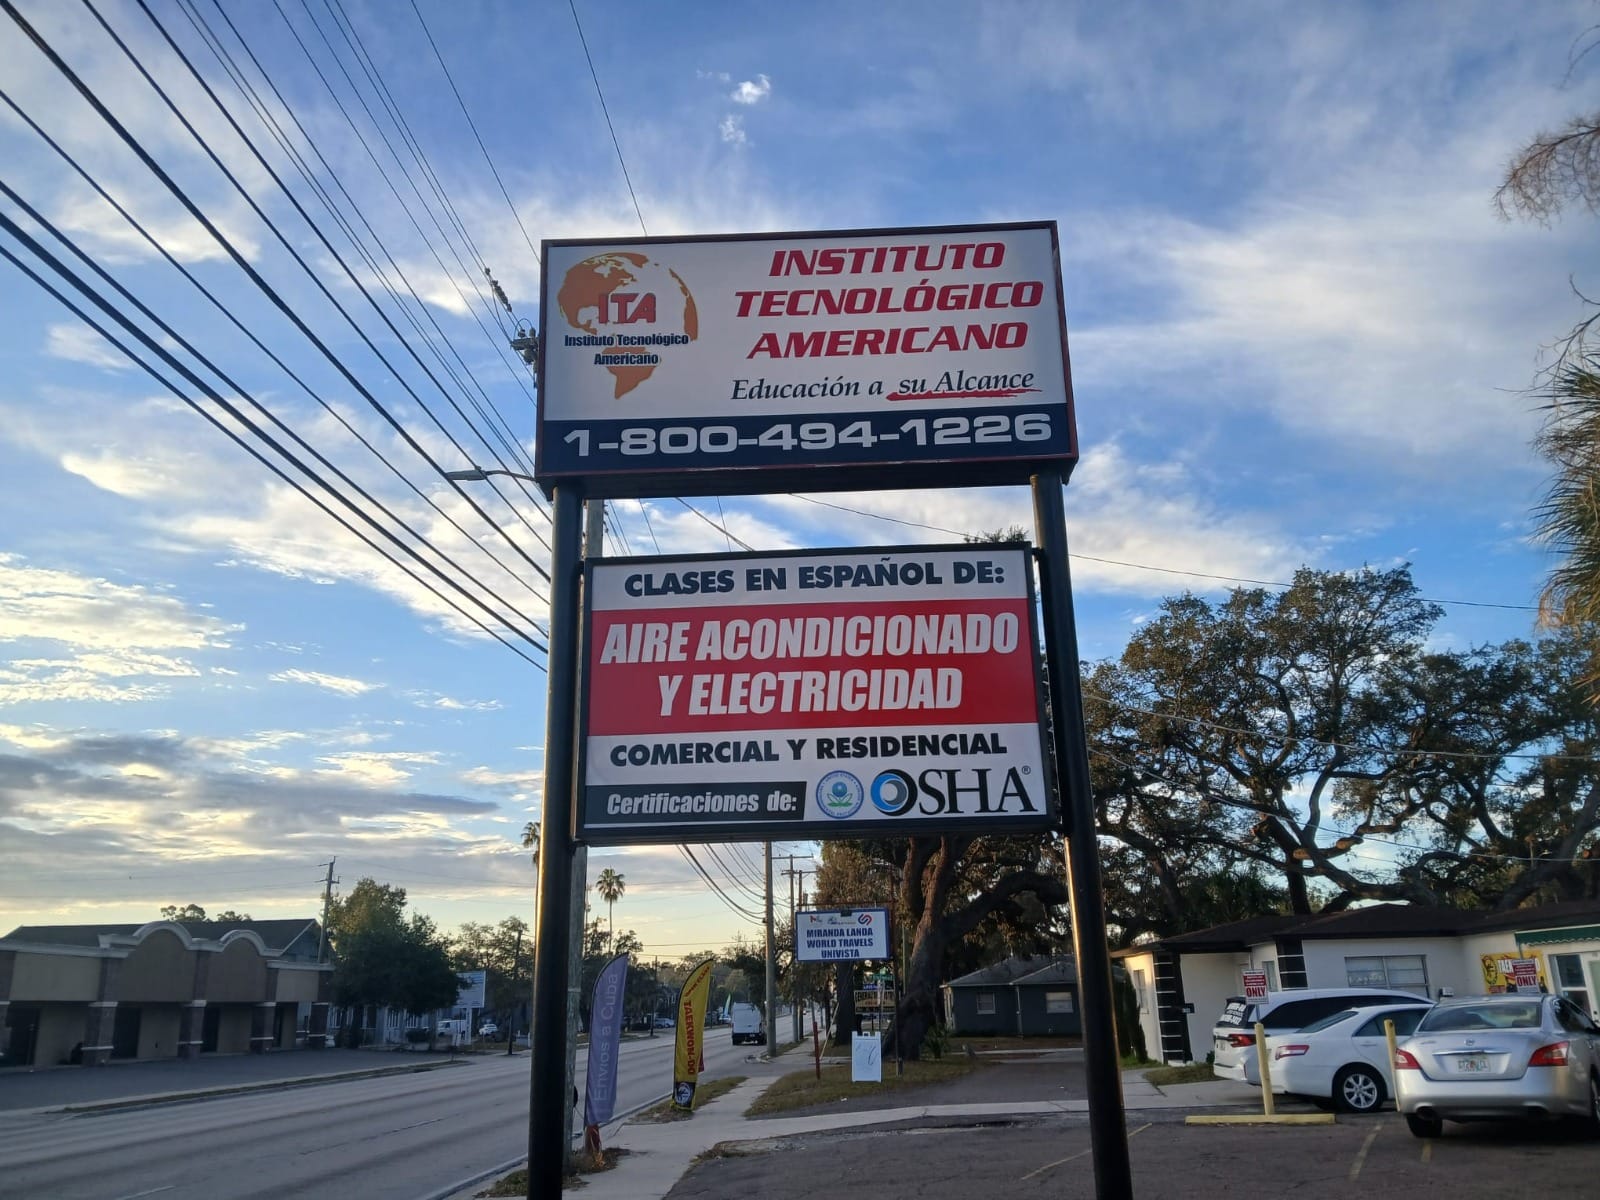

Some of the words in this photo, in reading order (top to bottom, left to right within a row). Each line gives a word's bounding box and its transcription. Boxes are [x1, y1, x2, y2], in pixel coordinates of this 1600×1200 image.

[768, 242, 1006, 277] INSTITUTO
[598, 292, 657, 325] ITA
[735, 278, 1044, 318] TECNOLÓGICO
[564, 334, 614, 348] Instituto
[616, 332, 689, 348] Tecnológico
[747, 321, 1029, 360] AMERICANO
[593, 352, 659, 366] Americano
[731, 376, 860, 401] Educación
[869, 382, 883, 396] a
[898, 378, 928, 395] su
[934, 369, 1035, 392] Alcance
[563, 413, 1053, 457] 1-800-494-1226
[624, 569, 735, 598] CLASES
[745, 567, 787, 592] EN
[798, 557, 943, 590] ESPAÑOL
[953, 561, 1005, 585] DE:
[600, 621, 691, 665] AIRE
[695, 611, 1019, 661] ACONDICIONADO
[658, 675, 685, 717] Y
[688, 667, 963, 716] ELECTRICIDAD
[610, 741, 779, 767] COMERCIAL
[787, 739, 809, 761] Y
[816, 733, 1007, 760] RESIDENCIAL
[607, 791, 760, 816] Certificaciones
[766, 790, 798, 813] de:
[806, 929, 845, 939] MIRANDA
[846, 927, 873, 937] LANDA
[806, 939, 837, 949] WORLD
[838, 938, 874, 948] TRAVELS
[821, 949, 860, 958] UNIVISTA
[601, 974, 617, 1020] Cuba
[1246, 987, 1266, 998] ONLY
[1517, 976, 1536, 987] ONLY
[602, 1026, 612, 1036] a
[683, 999, 697, 1076] TAEKWON-DO
[593, 1042, 611, 1102] Envios
